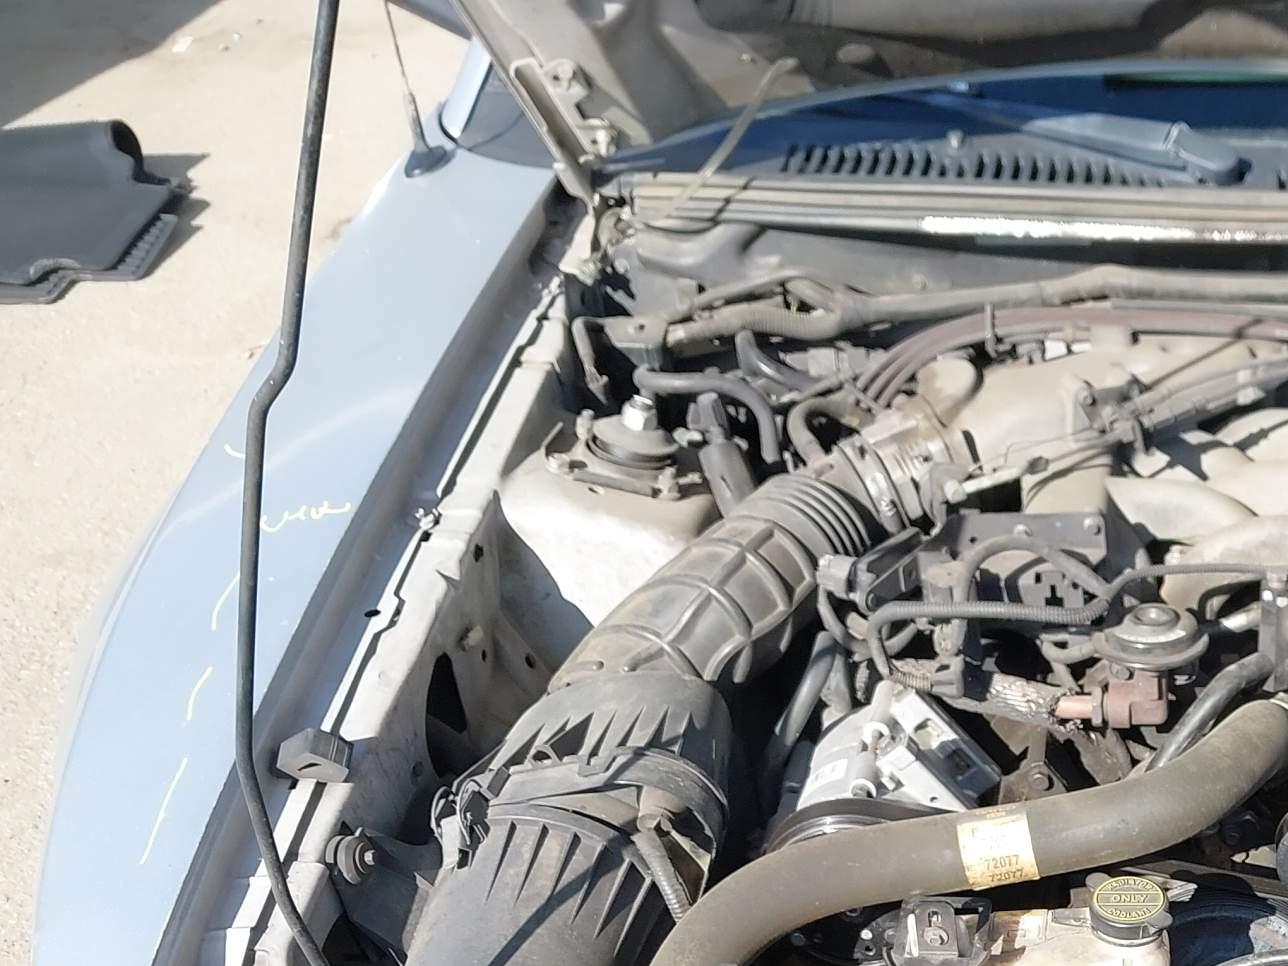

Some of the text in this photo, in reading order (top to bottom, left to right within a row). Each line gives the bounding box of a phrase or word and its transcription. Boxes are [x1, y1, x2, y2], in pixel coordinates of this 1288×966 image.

[983, 854, 1020, 871] 72077
[988, 867, 1024, 883] 72077
[1112, 894, 1149, 903] ONLY
[1107, 907, 1152, 919] COOLANT
